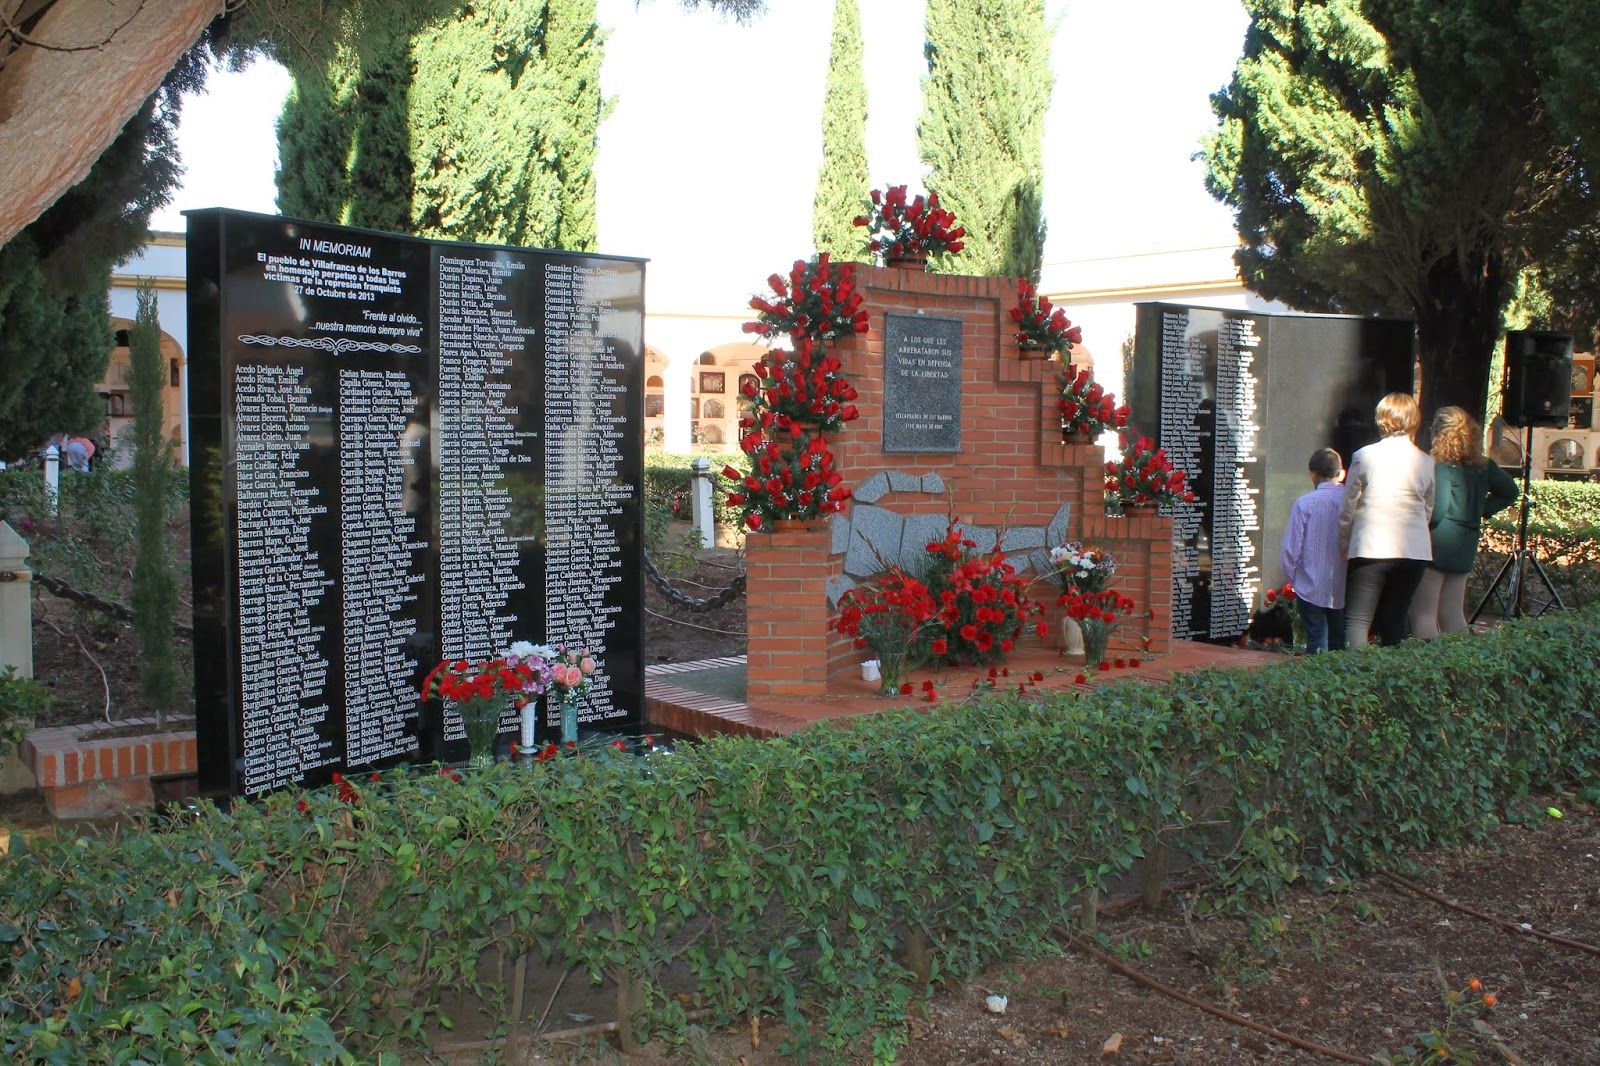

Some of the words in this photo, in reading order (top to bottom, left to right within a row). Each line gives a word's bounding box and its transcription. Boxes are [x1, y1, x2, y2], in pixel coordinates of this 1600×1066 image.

[300, 238, 311, 250] IN
[313, 240, 371, 258] MEMORIAM
[257, 252, 266, 262] El
[268, 256, 297, 265] pueblo
[300, 257, 310, 267] de
[312, 259, 355, 272] Villafranca
[357, 264, 367, 274] de
[368, 266, 380, 275] los
[382, 267, 407, 278] Barros
[265, 264, 276, 272] en
[279, 265, 319, 278] homenaje
[321, 271, 357, 282] perpetuo
[366, 274, 386, 284] todas
[388, 276, 400, 286] las
[264, 272, 300, 283] víctimas
[302, 276, 312, 285] de
[314, 276, 322, 285] la
[324, 279, 362, 289] represión
[364, 283, 401, 294] franquista
[294, 285, 302, 294] 27
[305, 286, 315, 296] de
[316, 287, 346, 298] Octubre
[347, 290, 357, 300] de
[358, 291, 375, 301] 2013
[388, 312, 396, 322] al
[345, 324, 376, 334] memoria
[378, 325, 405, 337] siempre
